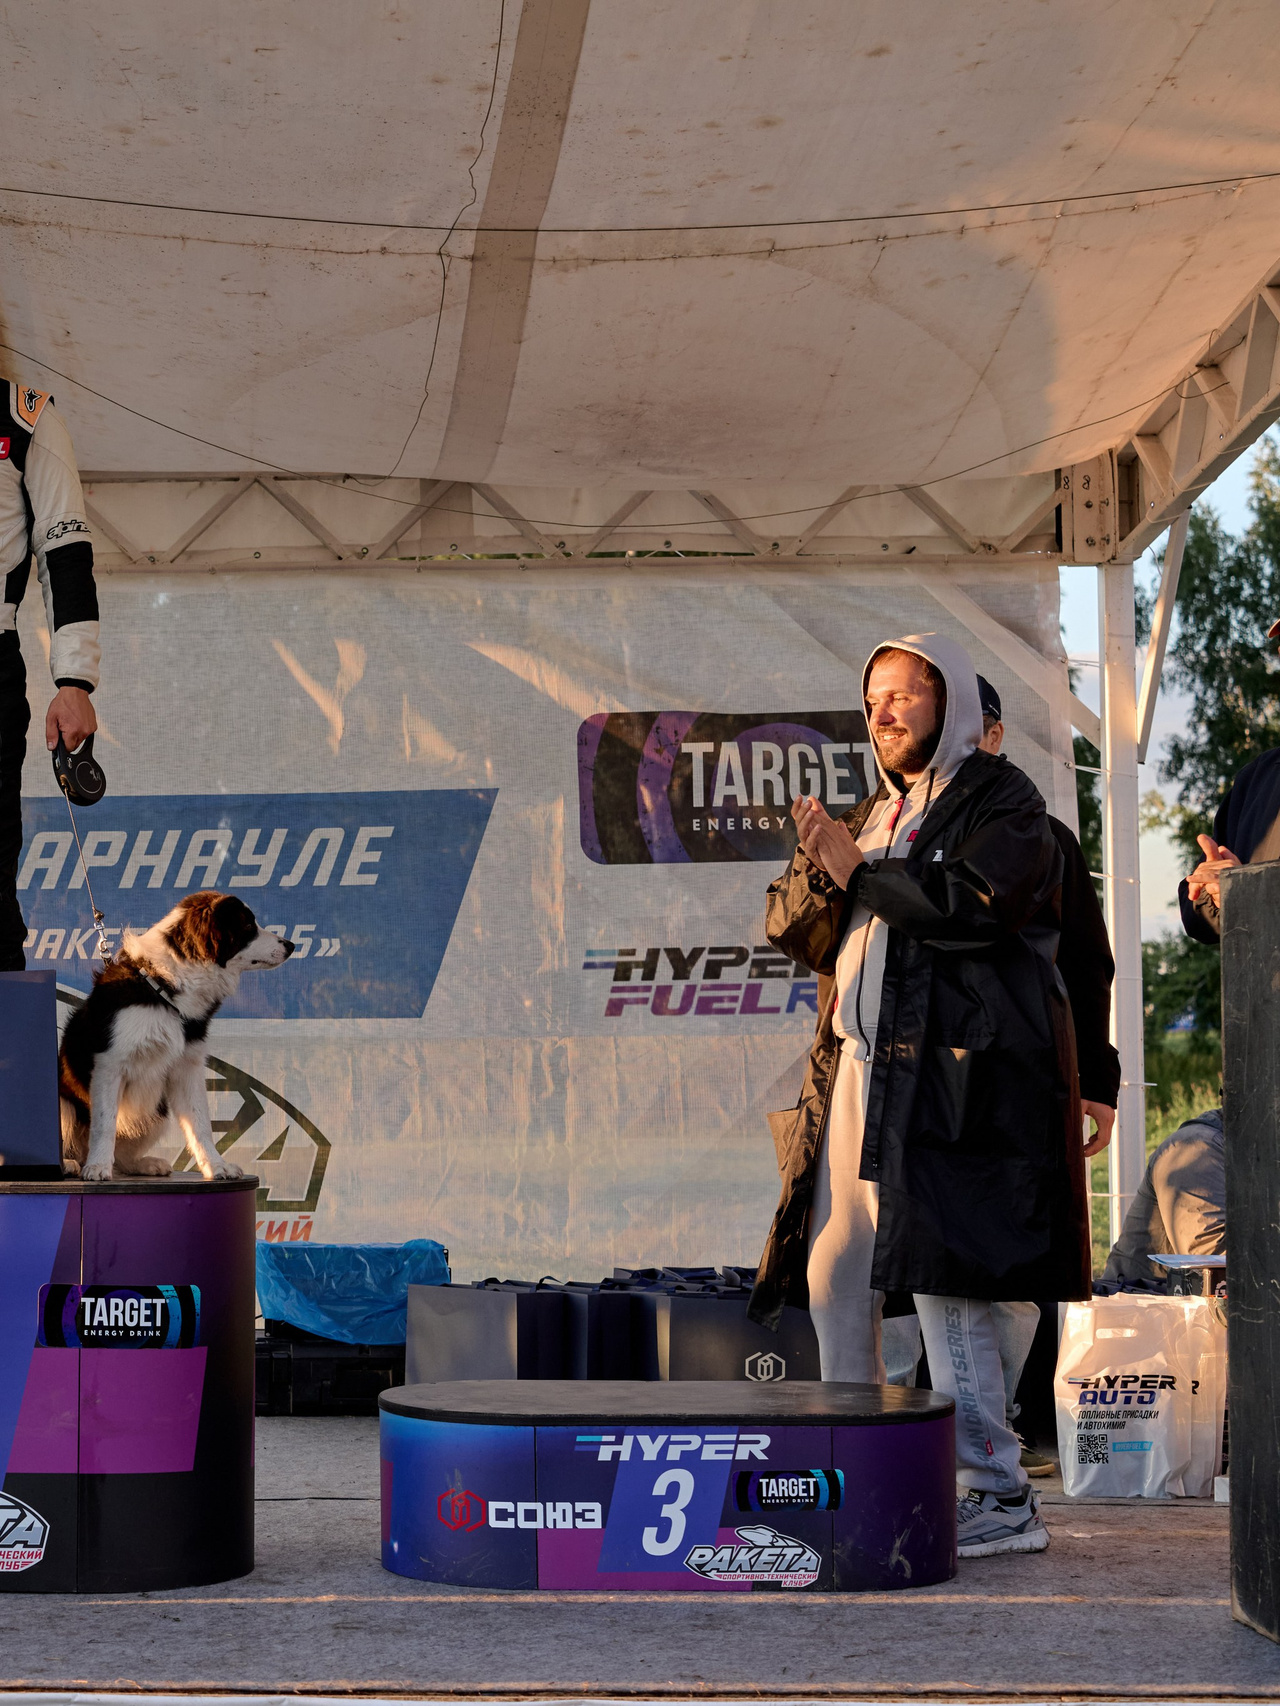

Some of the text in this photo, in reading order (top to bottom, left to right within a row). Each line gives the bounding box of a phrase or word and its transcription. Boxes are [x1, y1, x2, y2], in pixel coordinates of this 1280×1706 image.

[692, 816, 787, 831] ENERGY
[16, 826, 395, 891] АРНАУЛЕ
[80, 1297, 166, 1327] TARGET
[83, 1329, 124, 1337] ENERGY
[945, 1304, 968, 1372] SERIES
[1080, 1374, 1177, 1391] HYPER
[954, 1373, 984, 1426] DRIFT
[1078, 1390, 1157, 1406] AUTO
[1077, 1420, 1127, 1430] И АВТОХИМИЯ
[1078, 1410, 1160, 1420] ТОПЛИВНЫЕ ПРИСАДКИ
[598, 1434, 771, 1461] HYPER
[759, 1478, 817, 1497] TARGET
[488, 1501, 602, 1529] СОЮЗ
[642, 1468, 695, 1556] 3
[686, 1547, 819, 1572] РАКЕТА
[722, 1572, 818, 1580] СПОРТИВНО-ТЕХНИЧЕСКИЙ
